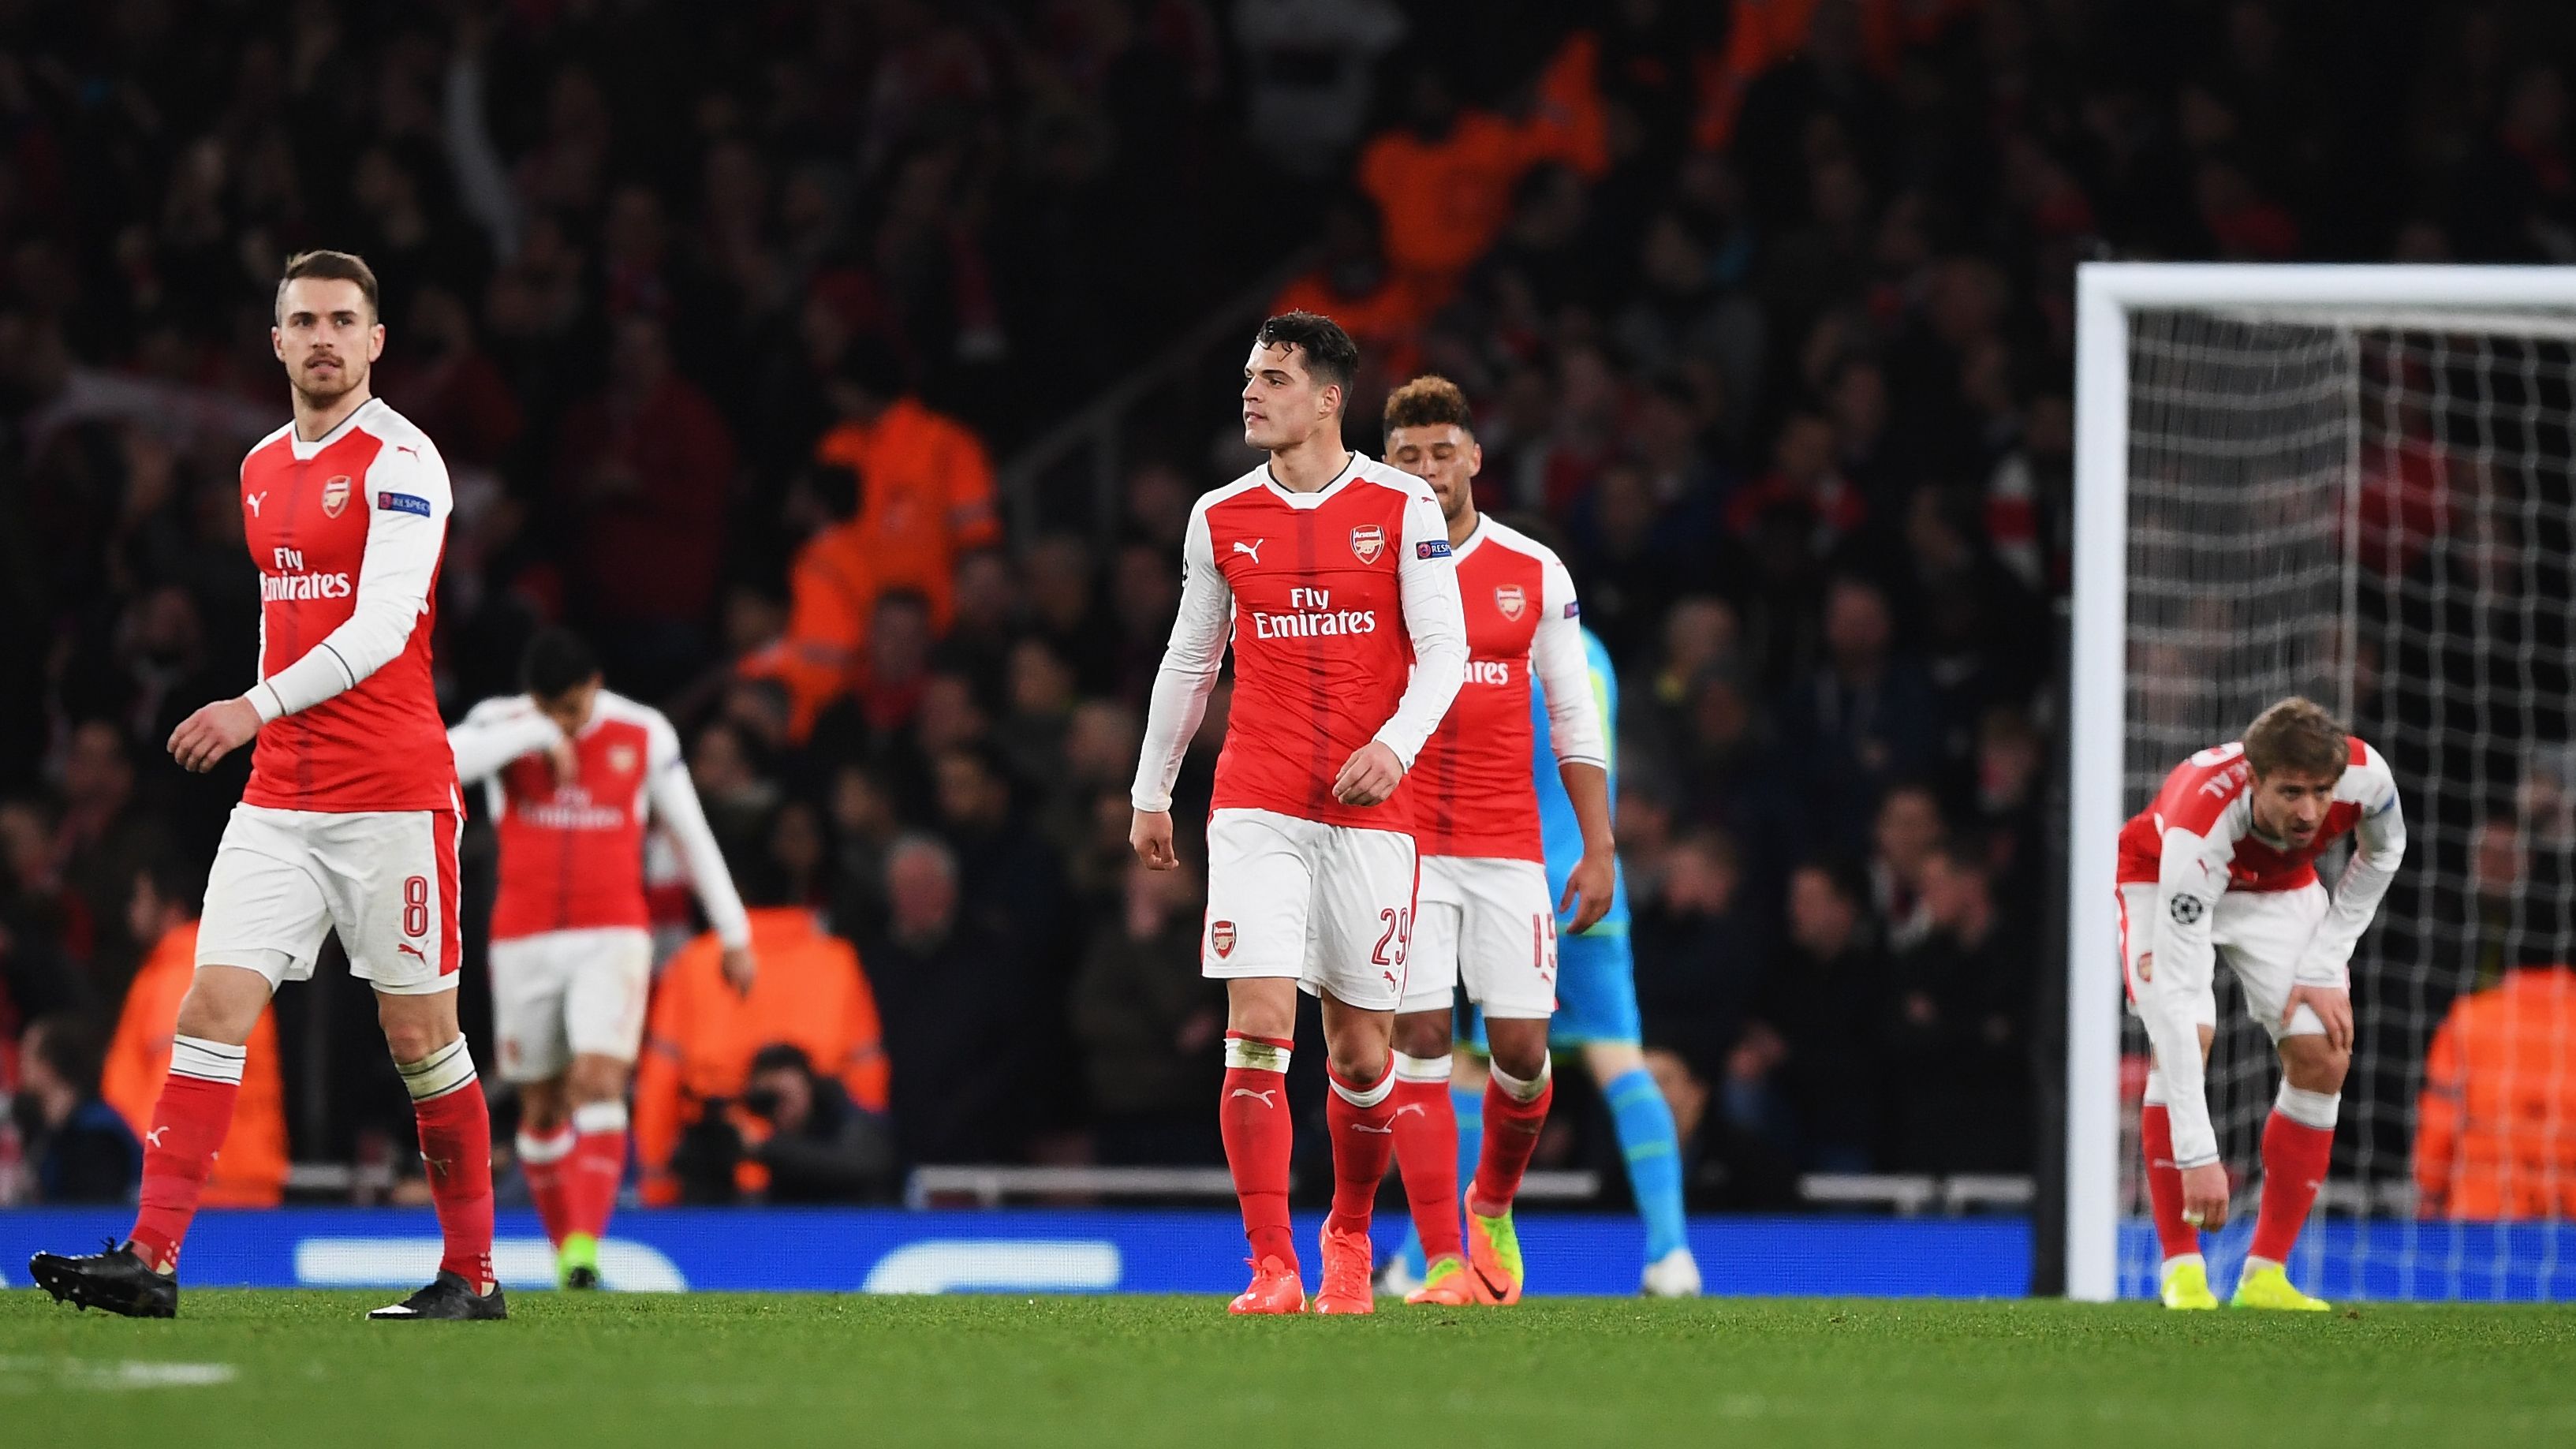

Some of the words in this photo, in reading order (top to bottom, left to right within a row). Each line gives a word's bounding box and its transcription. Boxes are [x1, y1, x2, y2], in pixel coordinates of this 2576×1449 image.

[392, 497, 431, 513] RESPEC
[274, 547, 304, 571] Fly
[1290, 588, 1329, 610] Fly
[1253, 608, 1376, 639] Emirates
[404, 876, 428, 937] 8
[1371, 907, 1408, 965] 29
